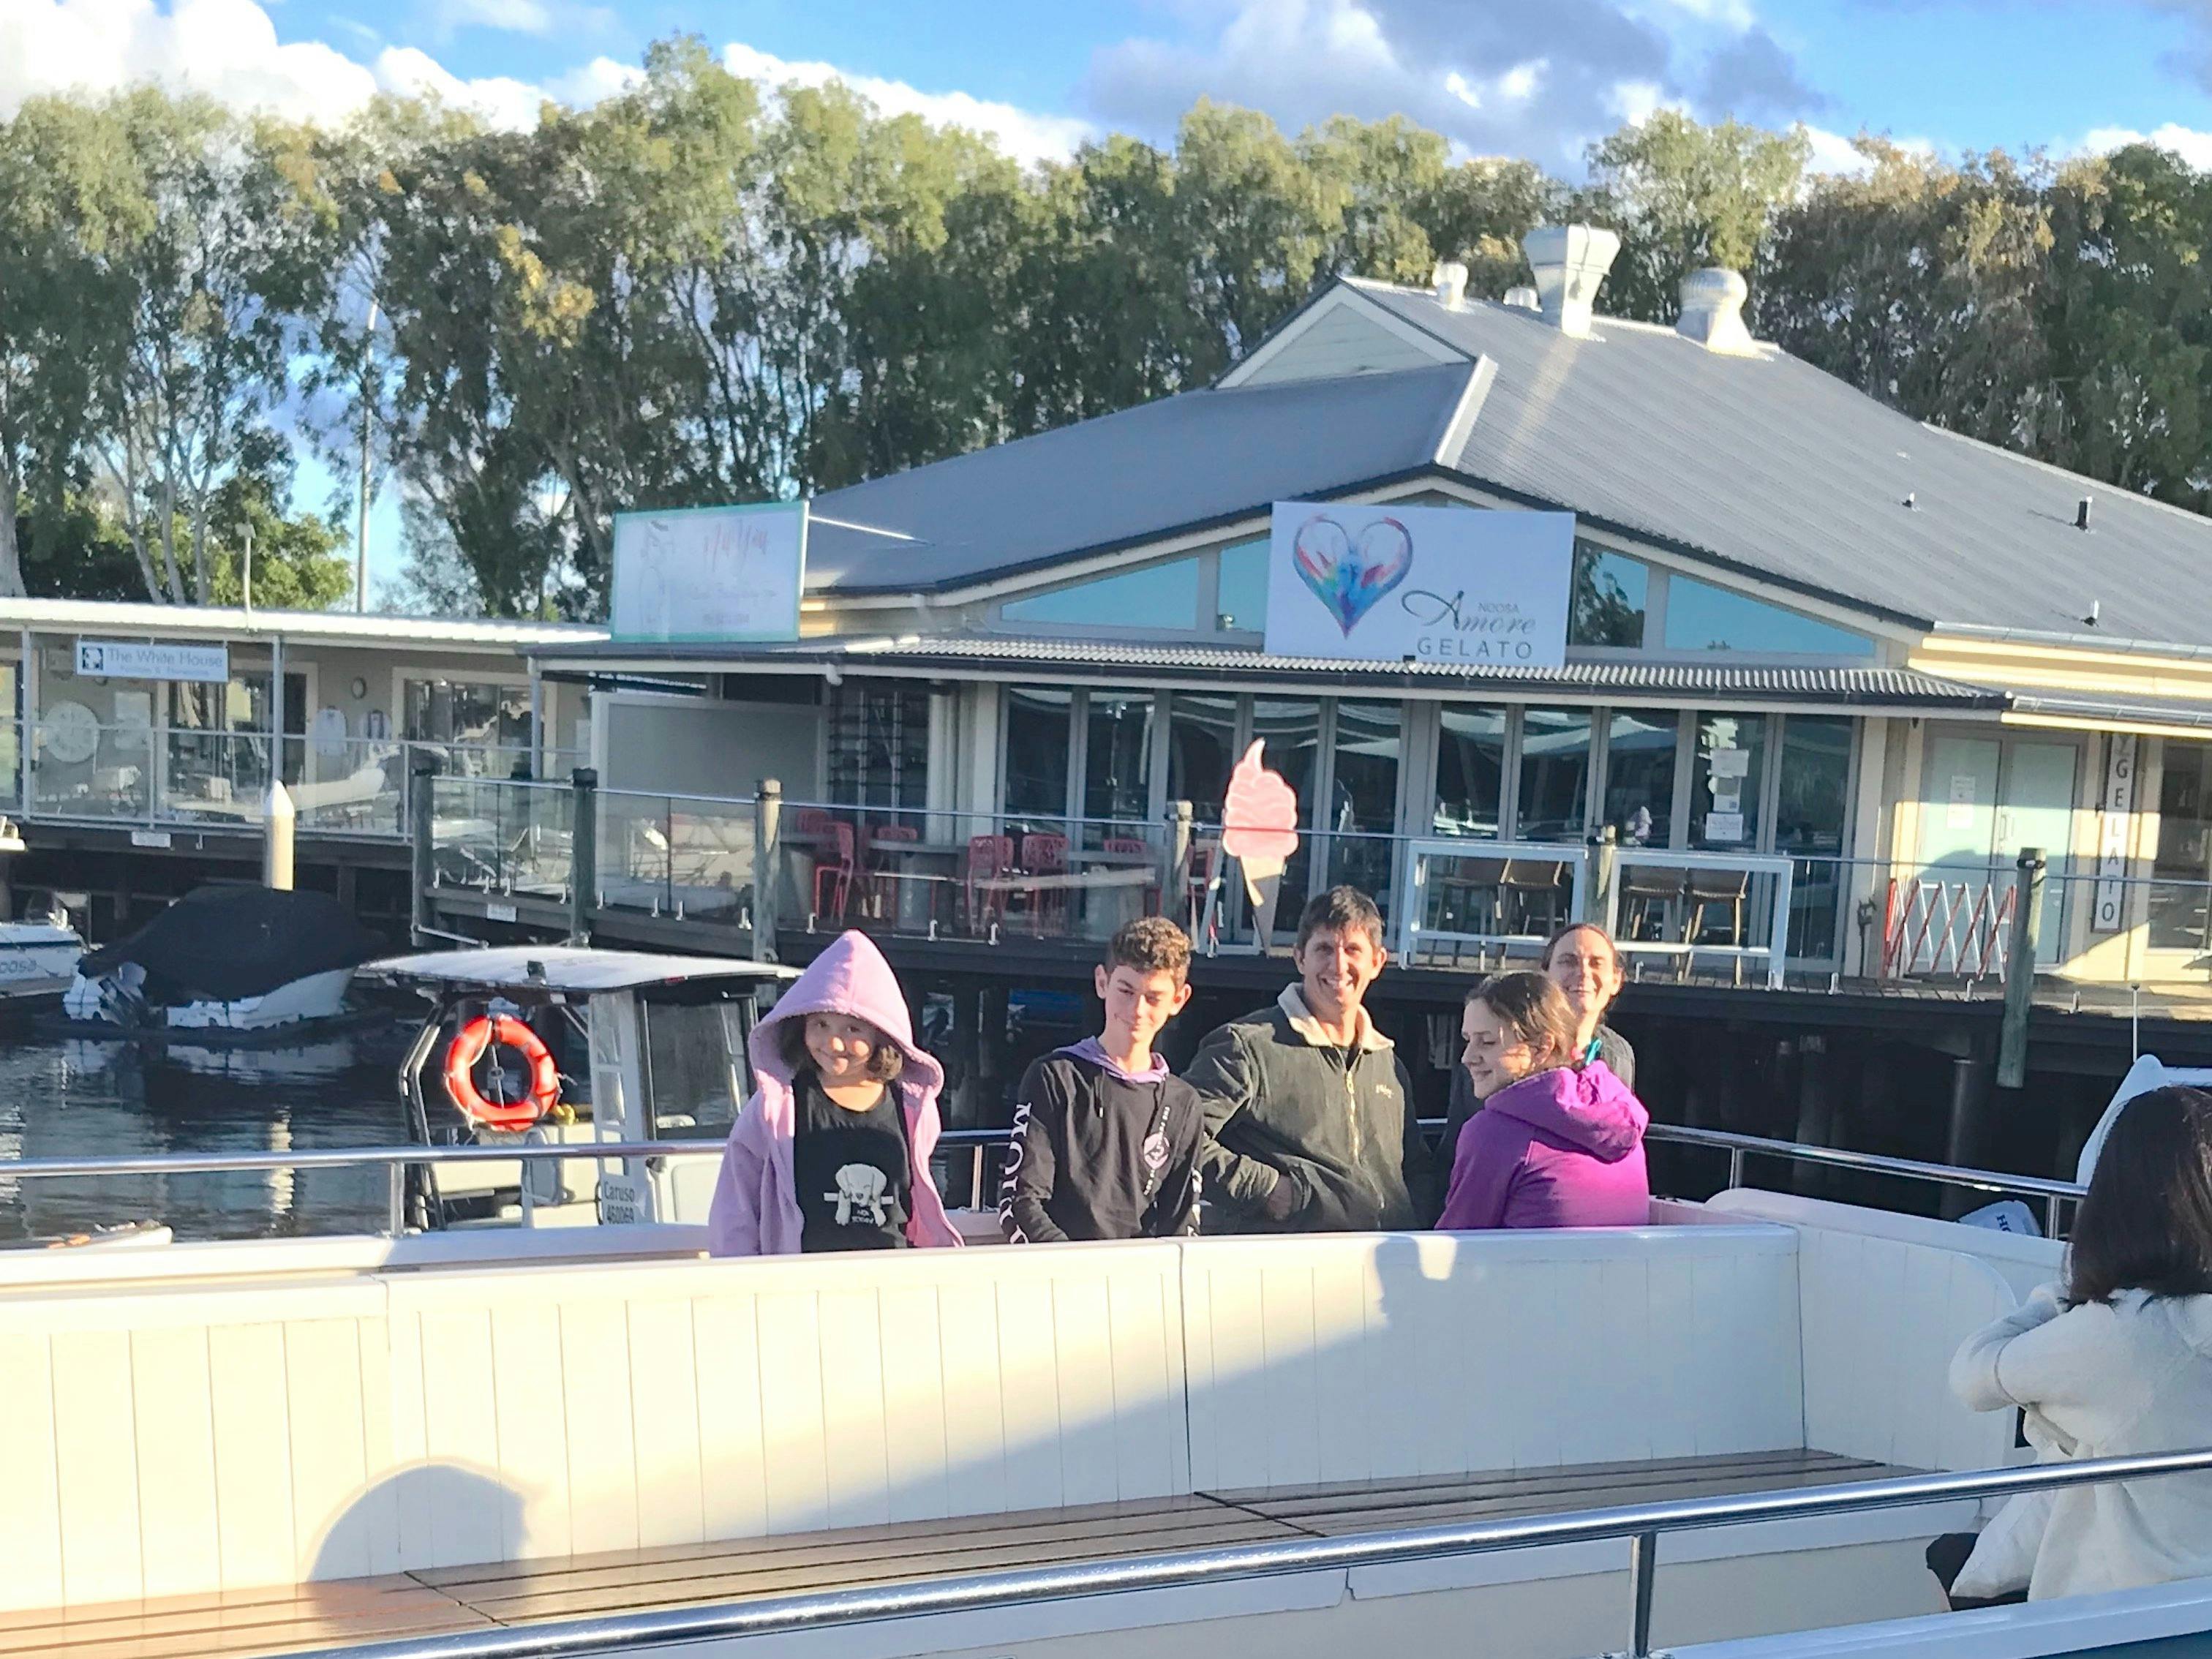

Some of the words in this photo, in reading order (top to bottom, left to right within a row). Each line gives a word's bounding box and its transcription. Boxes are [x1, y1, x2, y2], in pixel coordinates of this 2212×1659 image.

[1402, 590, 1535, 635] Amore
[109, 648, 132, 662] The
[136, 649, 175, 665] White
[179, 651, 223, 667] House
[1417, 636, 1532, 659] GELATO
[2102, 759, 2129, 922] GELATO
[603, 1181, 635, 1203] Caruso
